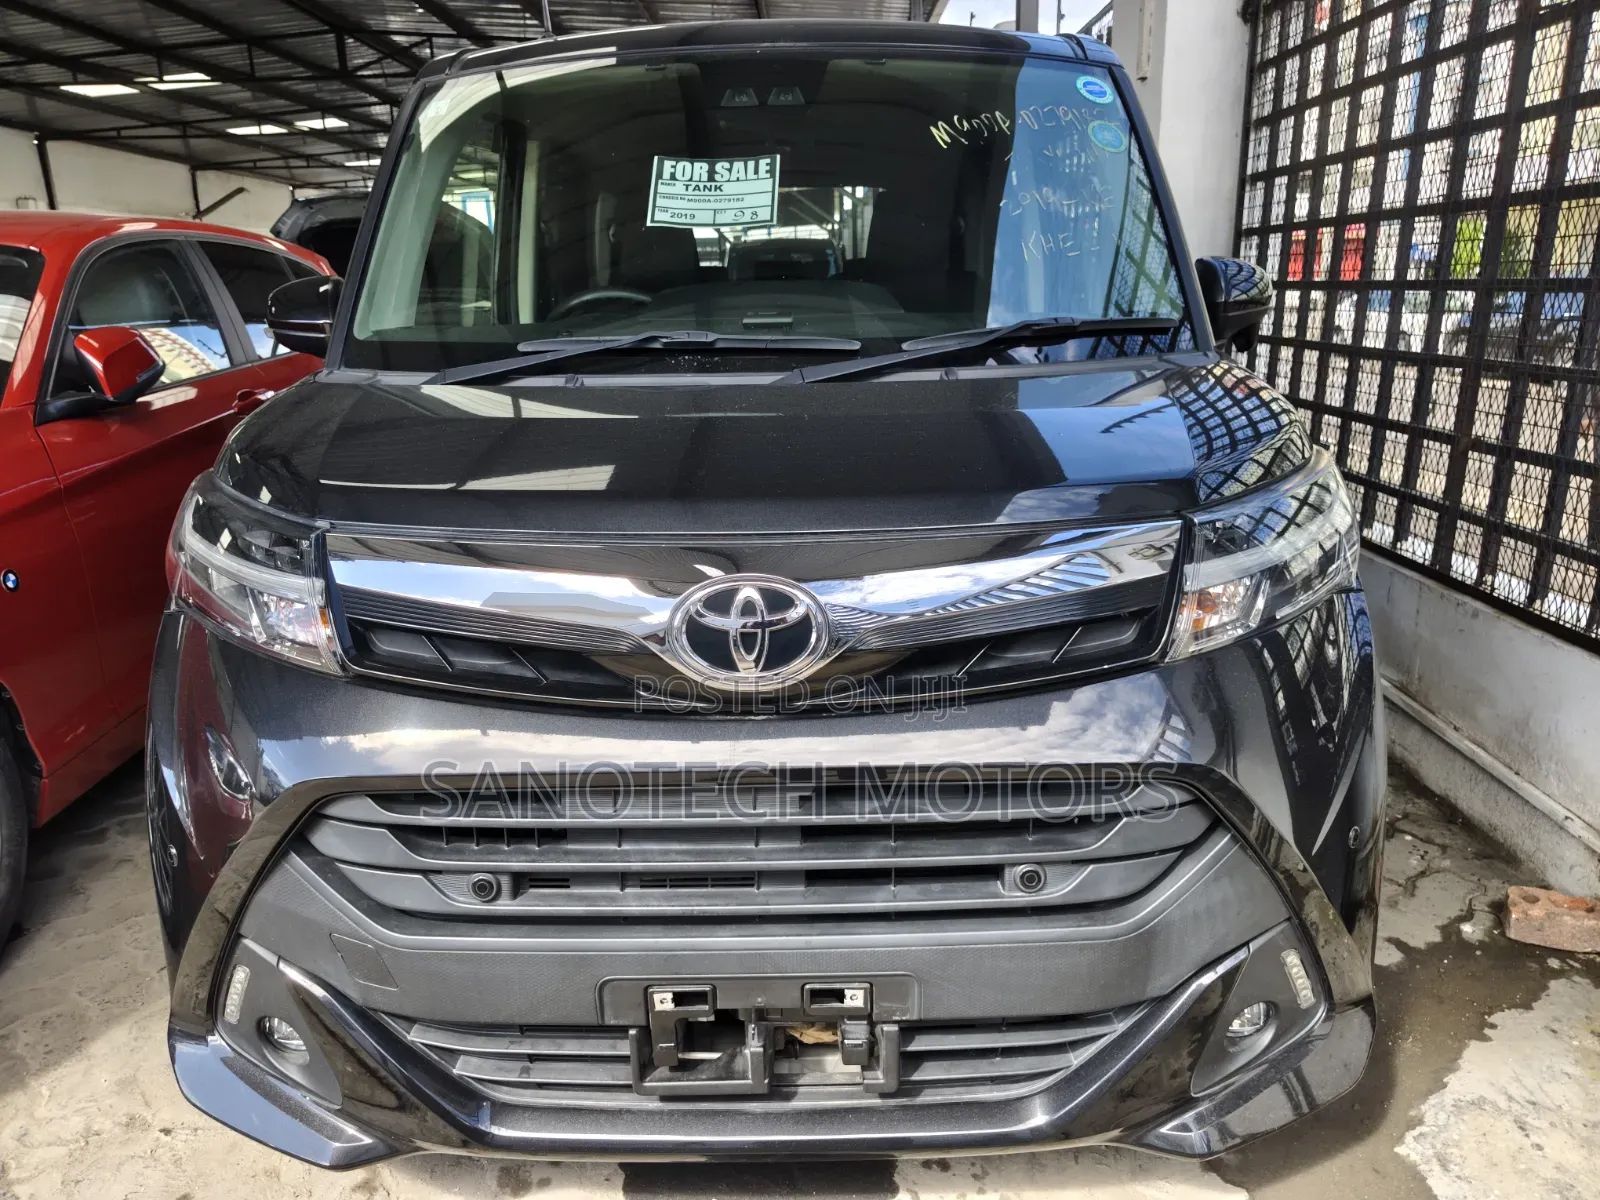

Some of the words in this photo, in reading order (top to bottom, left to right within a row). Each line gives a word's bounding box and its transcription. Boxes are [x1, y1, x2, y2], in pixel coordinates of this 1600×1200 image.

[662, 160, 709, 182] FOR
[714, 158, 771, 182] SALE
[682, 183, 724, 193] TANK
[669, 211, 696, 220] 2019
